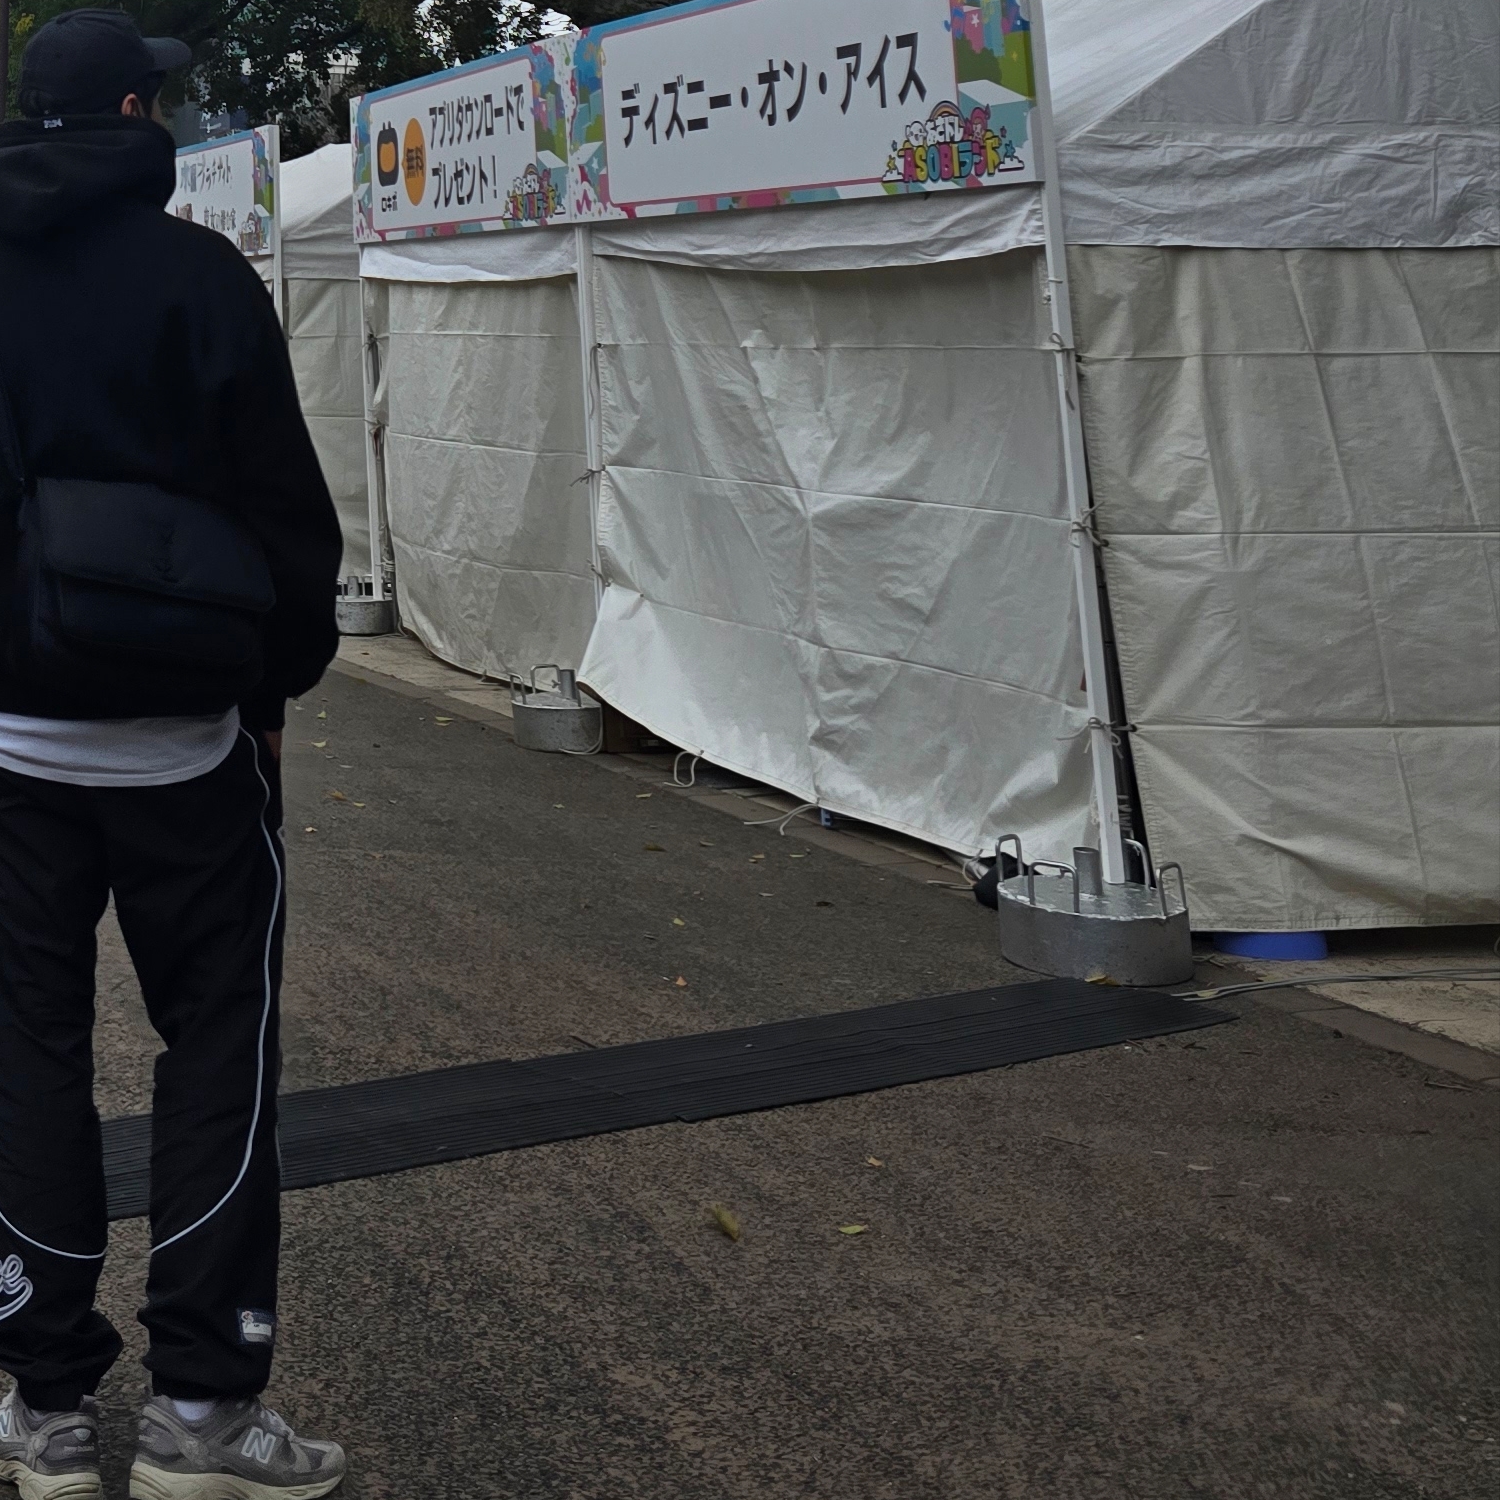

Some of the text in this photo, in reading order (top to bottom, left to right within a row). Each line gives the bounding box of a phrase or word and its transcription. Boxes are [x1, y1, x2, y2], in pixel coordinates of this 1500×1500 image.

[621, 32, 927, 148] ディズニー・オン・アイス
[429, 84, 525, 149] アプリダウンロードで
[407, 144, 424, 179] 無料
[241, 1426, 276, 1464] N
